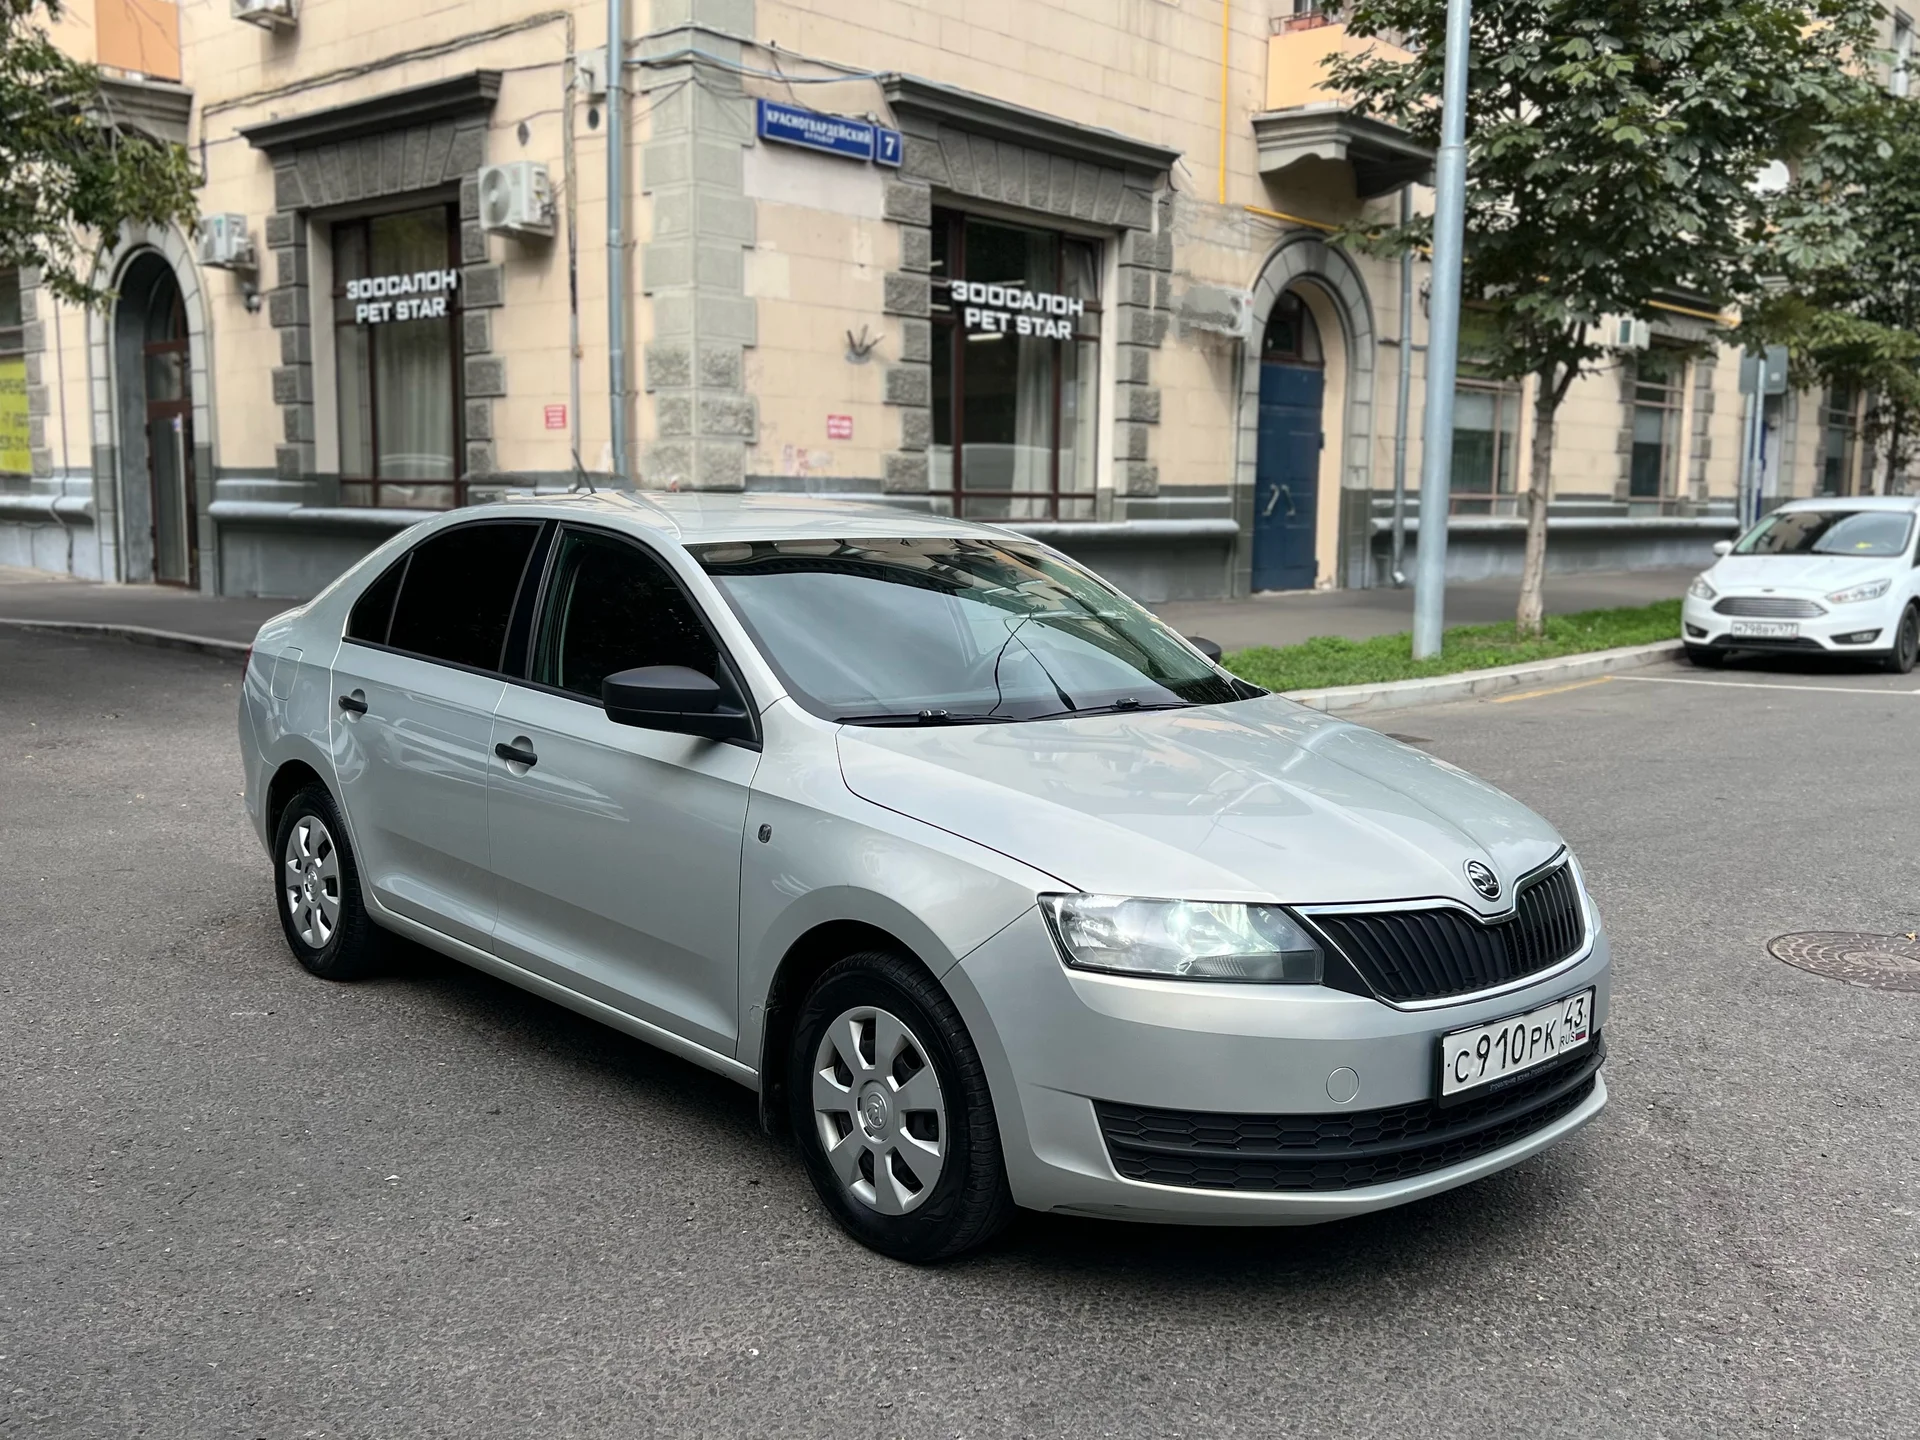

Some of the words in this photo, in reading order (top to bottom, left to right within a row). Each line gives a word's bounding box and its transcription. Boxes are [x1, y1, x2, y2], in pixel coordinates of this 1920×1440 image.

[885, 137, 895, 156] 7
[346, 268, 457, 300] ЗООСАЛОН
[951, 280, 1084, 317] ЗООСАЛОН
[356, 301, 392, 324] PET
[395, 296, 446, 320] STAR
[965, 307, 1011, 332] PET
[1015, 315, 1072, 340] STAR
[1564, 997, 1584, 1031] 43
[1560, 1033, 1575, 1046] RUS
